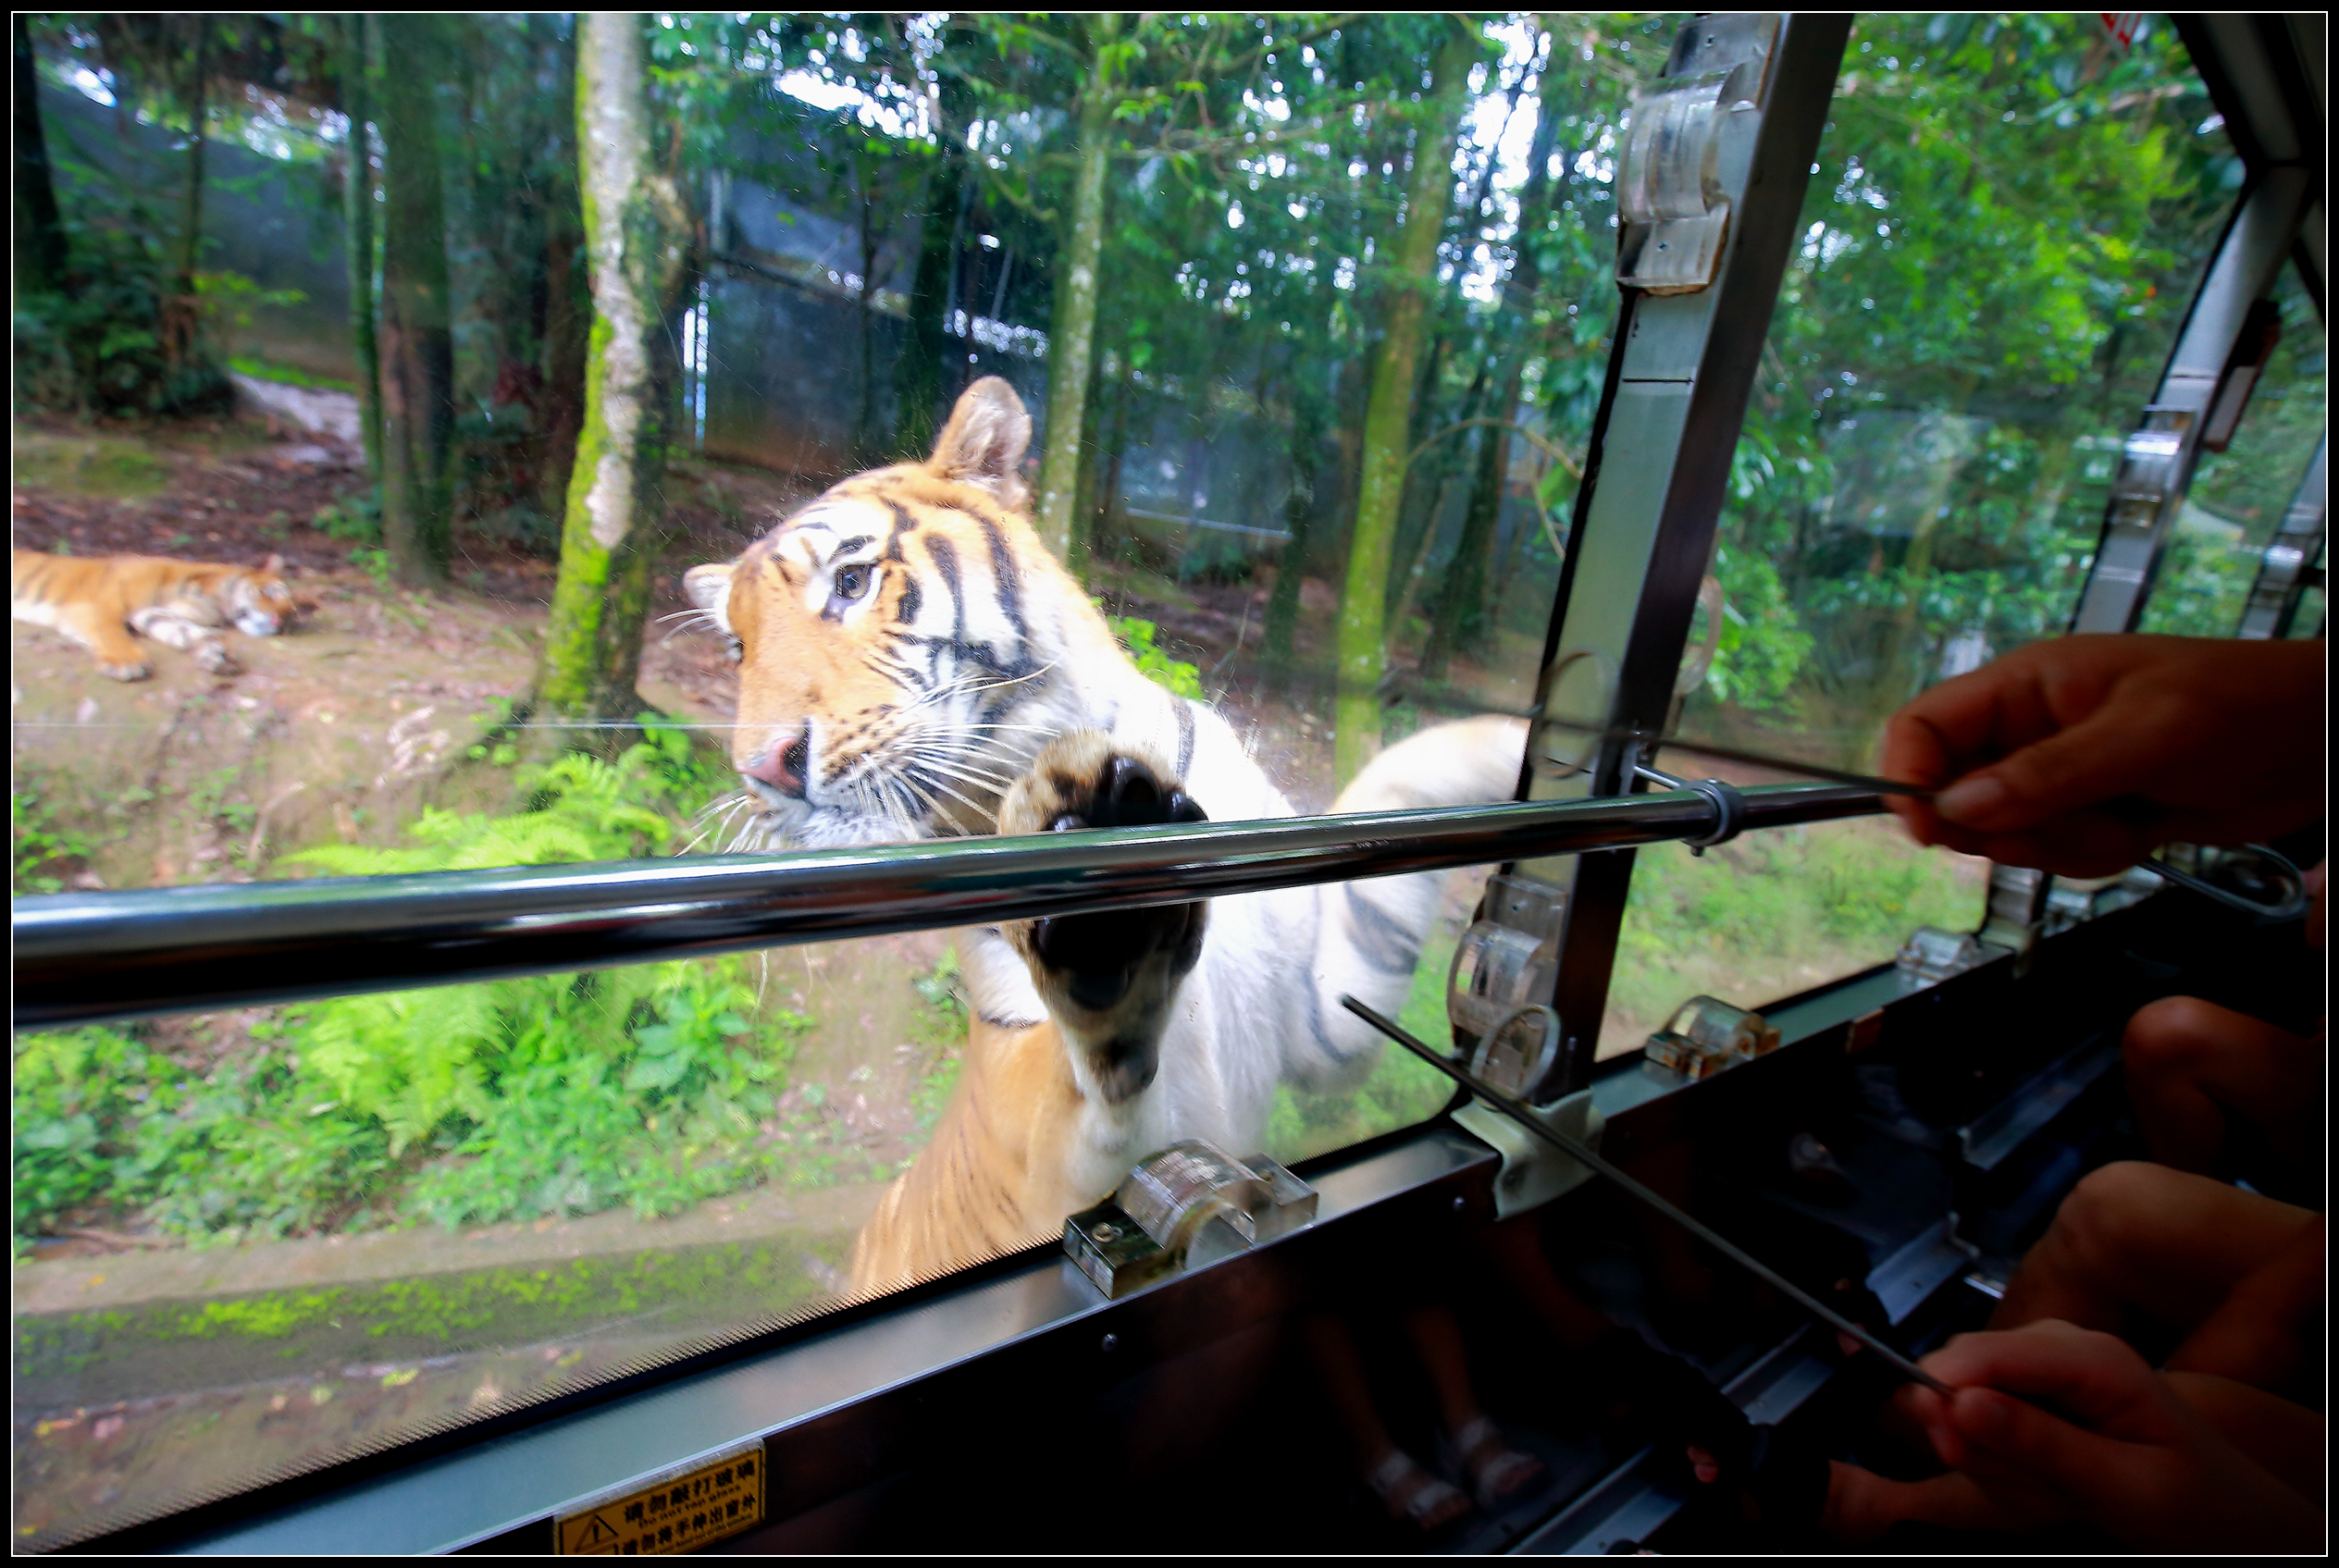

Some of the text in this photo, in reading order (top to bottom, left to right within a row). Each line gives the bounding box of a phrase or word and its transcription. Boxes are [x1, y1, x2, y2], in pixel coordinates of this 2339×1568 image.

[624, 1459, 754, 1524] 请勿敲打玻璃
[660, 1507, 681, 1520] not
